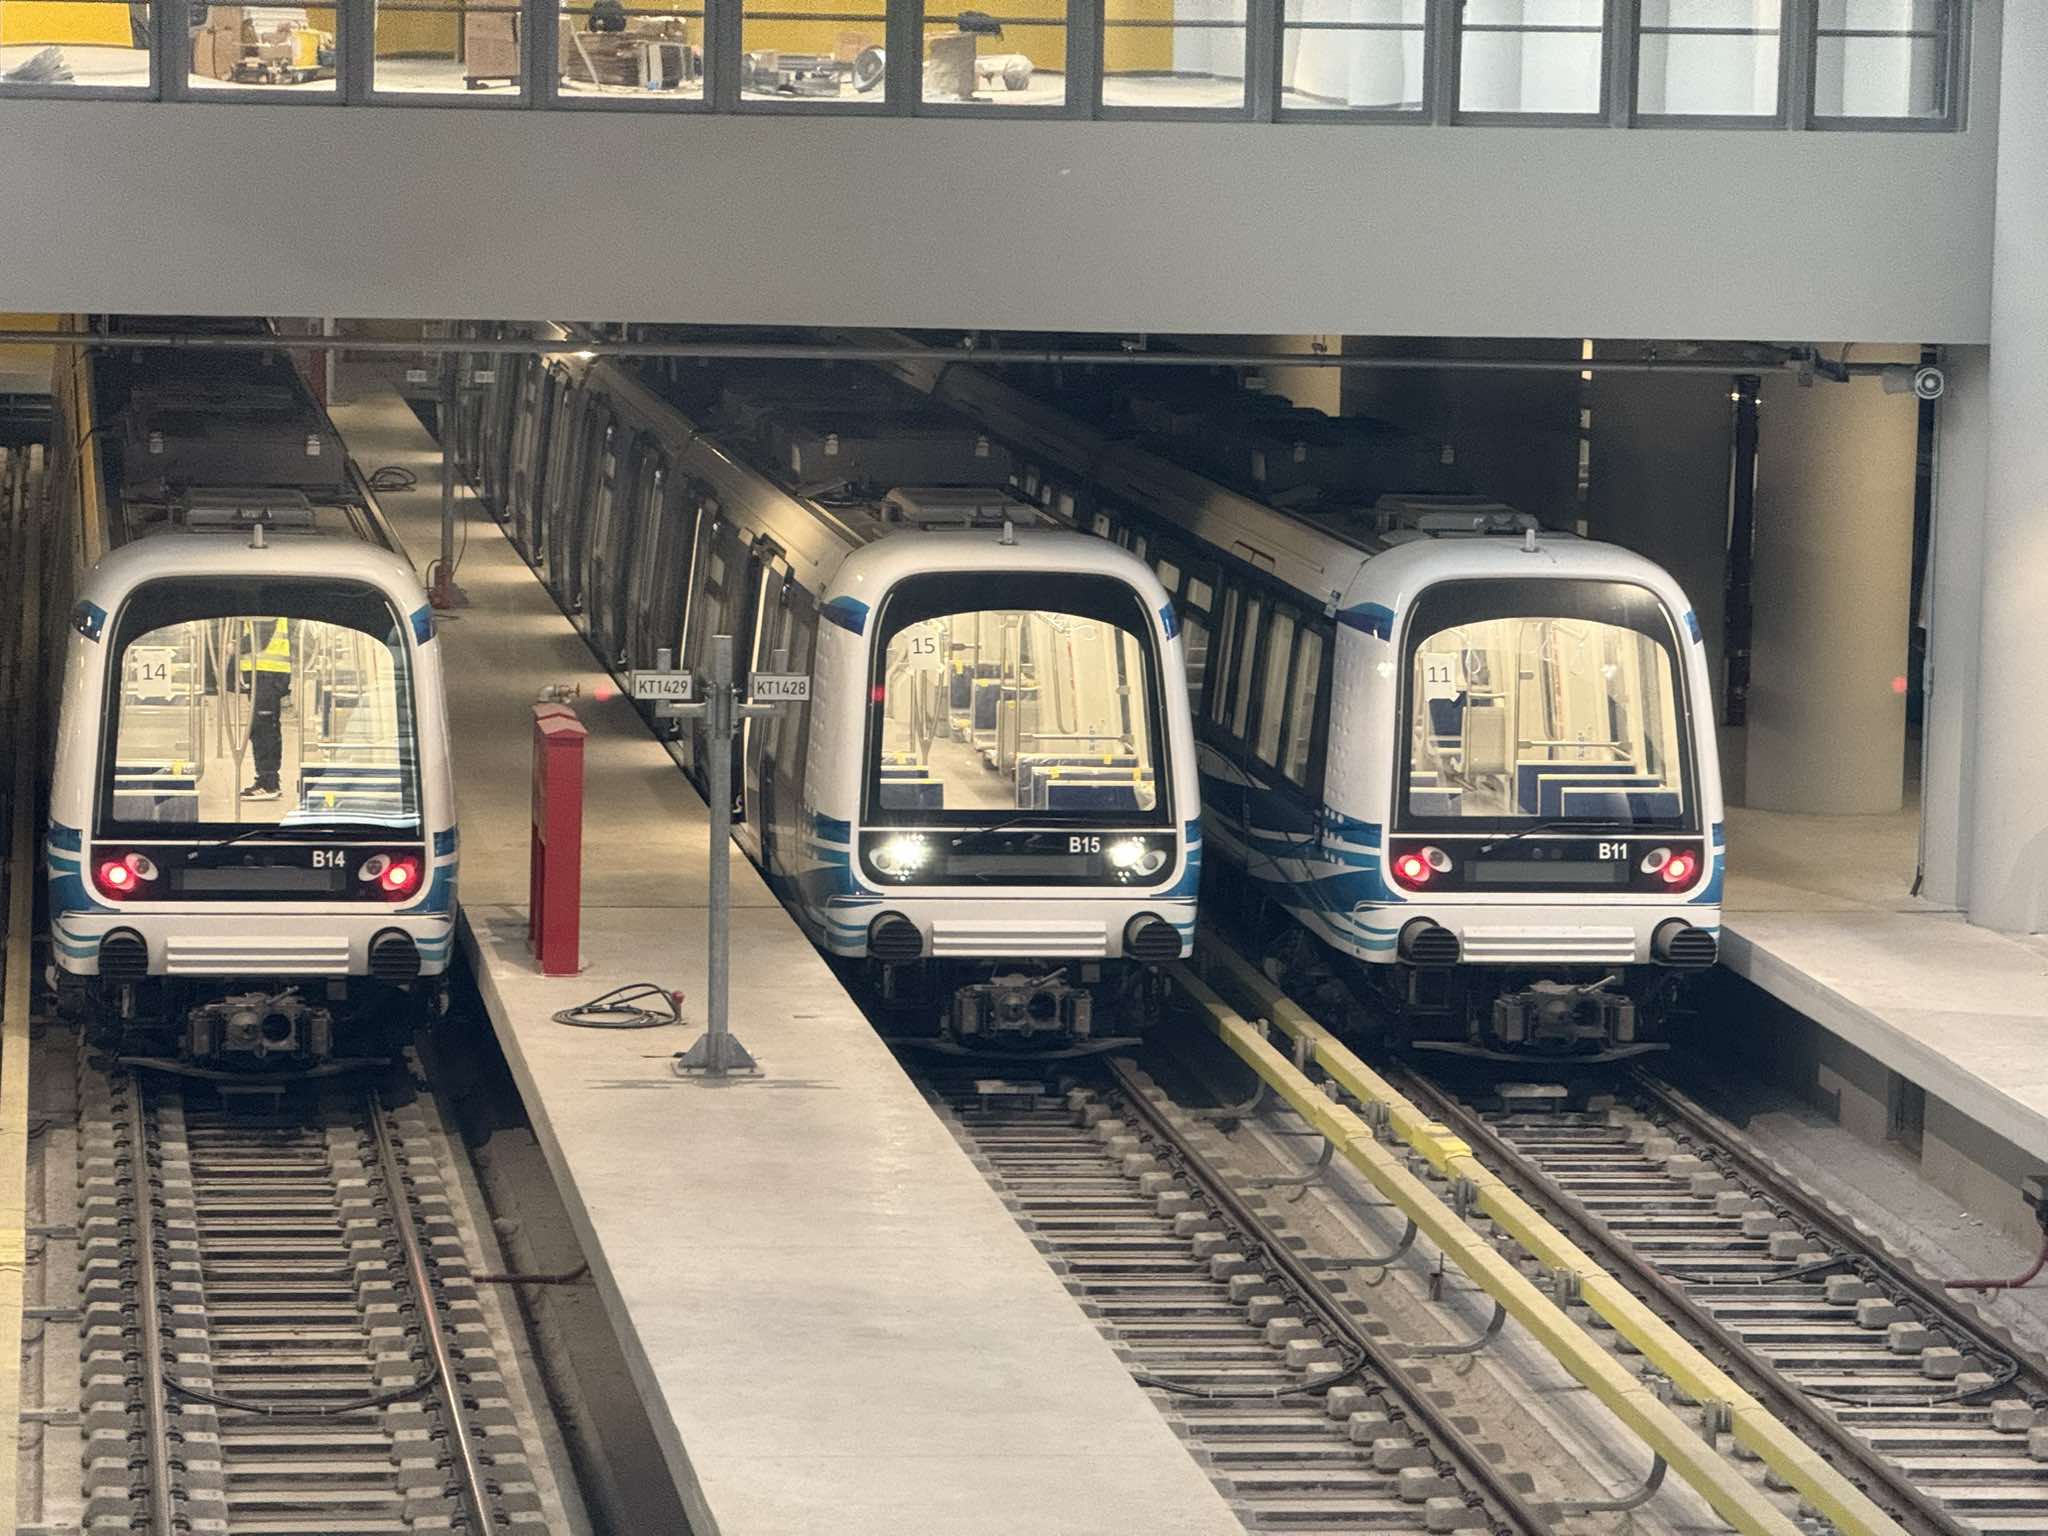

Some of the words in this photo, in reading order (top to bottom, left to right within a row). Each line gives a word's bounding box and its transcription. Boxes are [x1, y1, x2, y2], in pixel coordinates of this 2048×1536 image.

[912, 637, 936, 654] 15
[143, 663, 168, 681] 14
[1428, 666, 1452, 683] 11
[638, 680, 689, 694] KT1429
[756, 681, 807, 696] KT1428
[1069, 836, 1101, 853] B15
[1599, 842, 1628, 860] B11
[312, 850, 346, 868] B14
